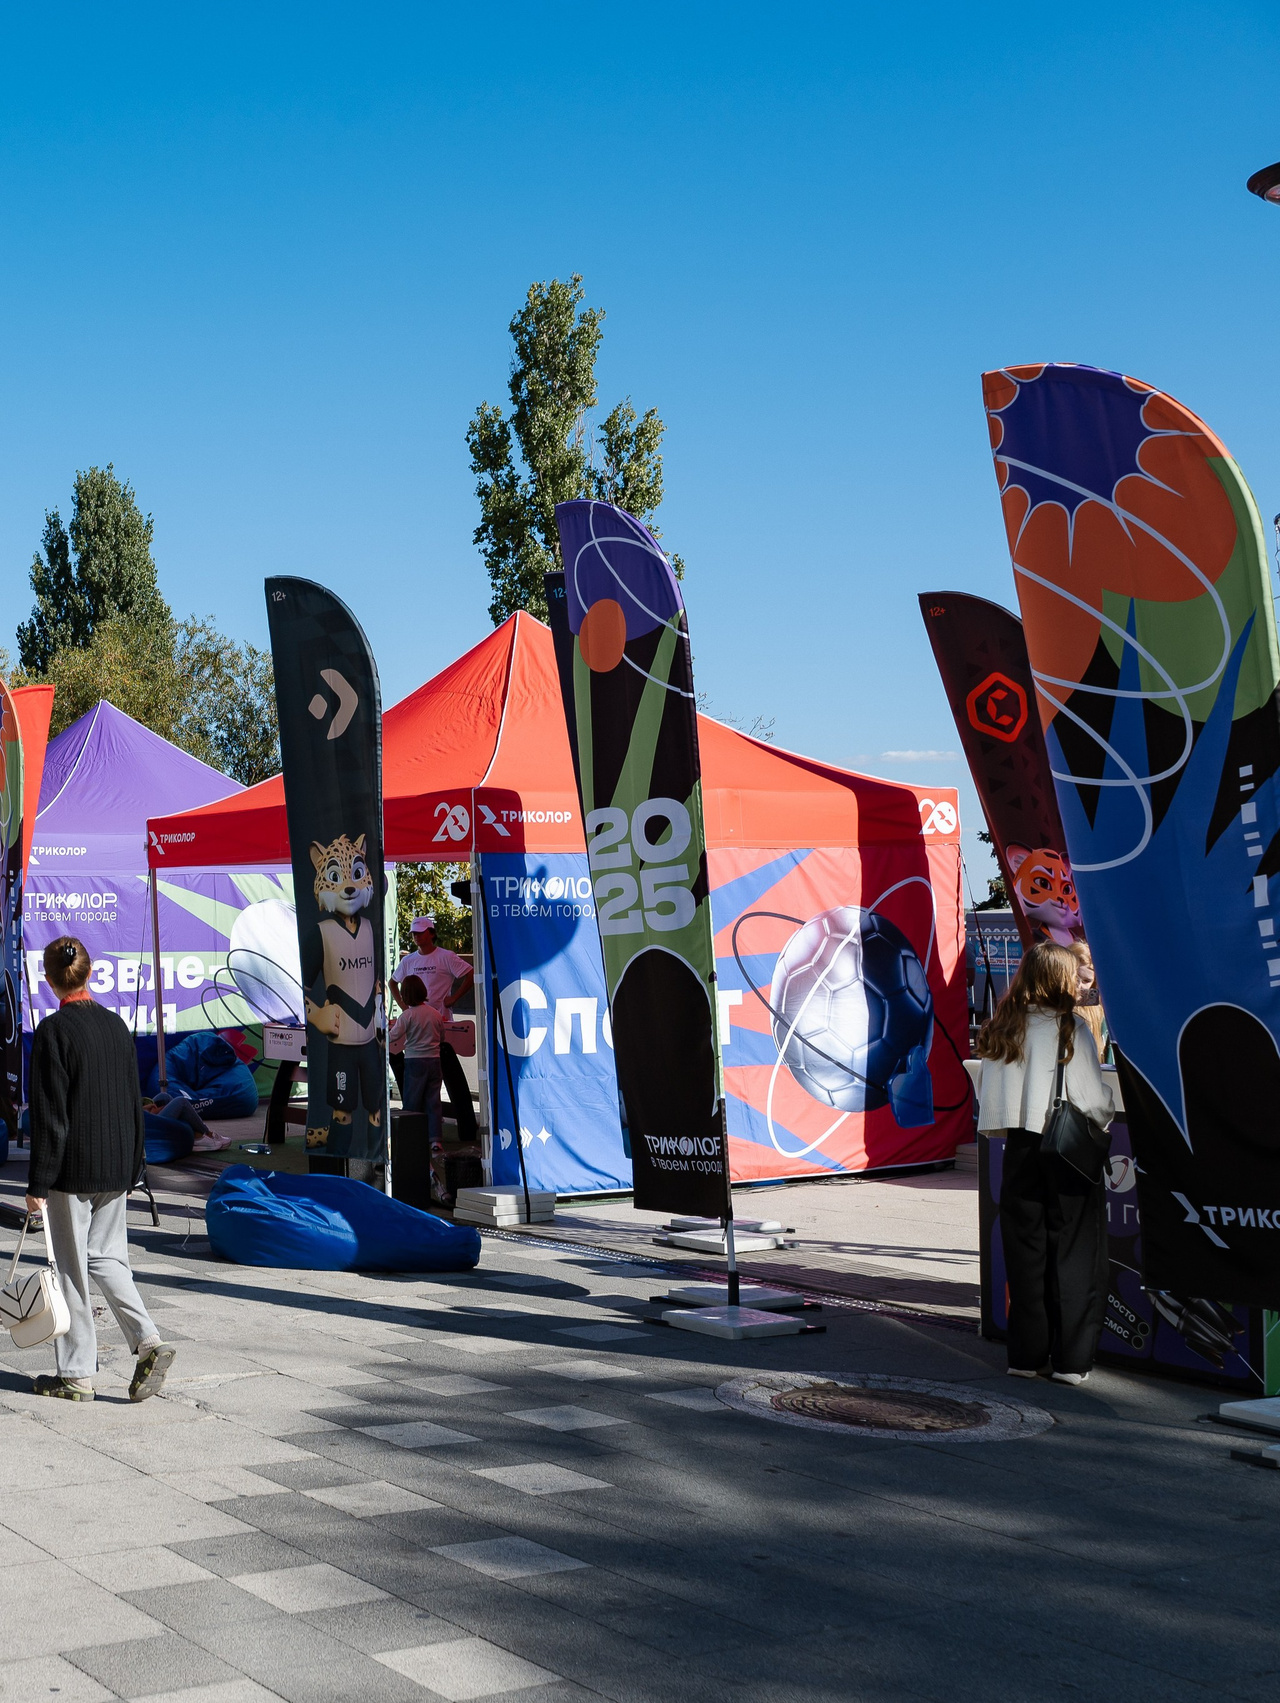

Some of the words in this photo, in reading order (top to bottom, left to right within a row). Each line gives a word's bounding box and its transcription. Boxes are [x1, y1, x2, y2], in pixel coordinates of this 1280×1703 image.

[272, 590, 287, 602] 12+
[929, 606, 946, 617] 12+
[431, 802, 470, 842] 20
[500, 810, 572, 823] ТРИКОЛОР
[918, 798, 957, 835] 20
[160, 832, 196, 844] ТРИКОЛОР
[586, 797, 692, 871] 20
[32, 846, 87, 856] ТРИКОЛОР
[490, 876, 593, 900] ТРИКОЛО
[24, 892, 117, 909] ТРИКОЛОР
[594, 864, 697, 936] 25
[24, 912, 31, 922] в
[34, 912, 71, 922] твоем
[75, 911, 117, 924] городе
[491, 904, 500, 918] в
[503, 904, 552, 918] твоем
[557, 904, 597, 920] горо
[347, 956, 373, 969] МЯЧ
[26, 950, 228, 994] Рзвле-
[498, 979, 743, 1057] Спт
[335, 1071, 347, 1091] 12
[657, 1158, 690, 1171] твоем
[691, 1160, 723, 1175] город
